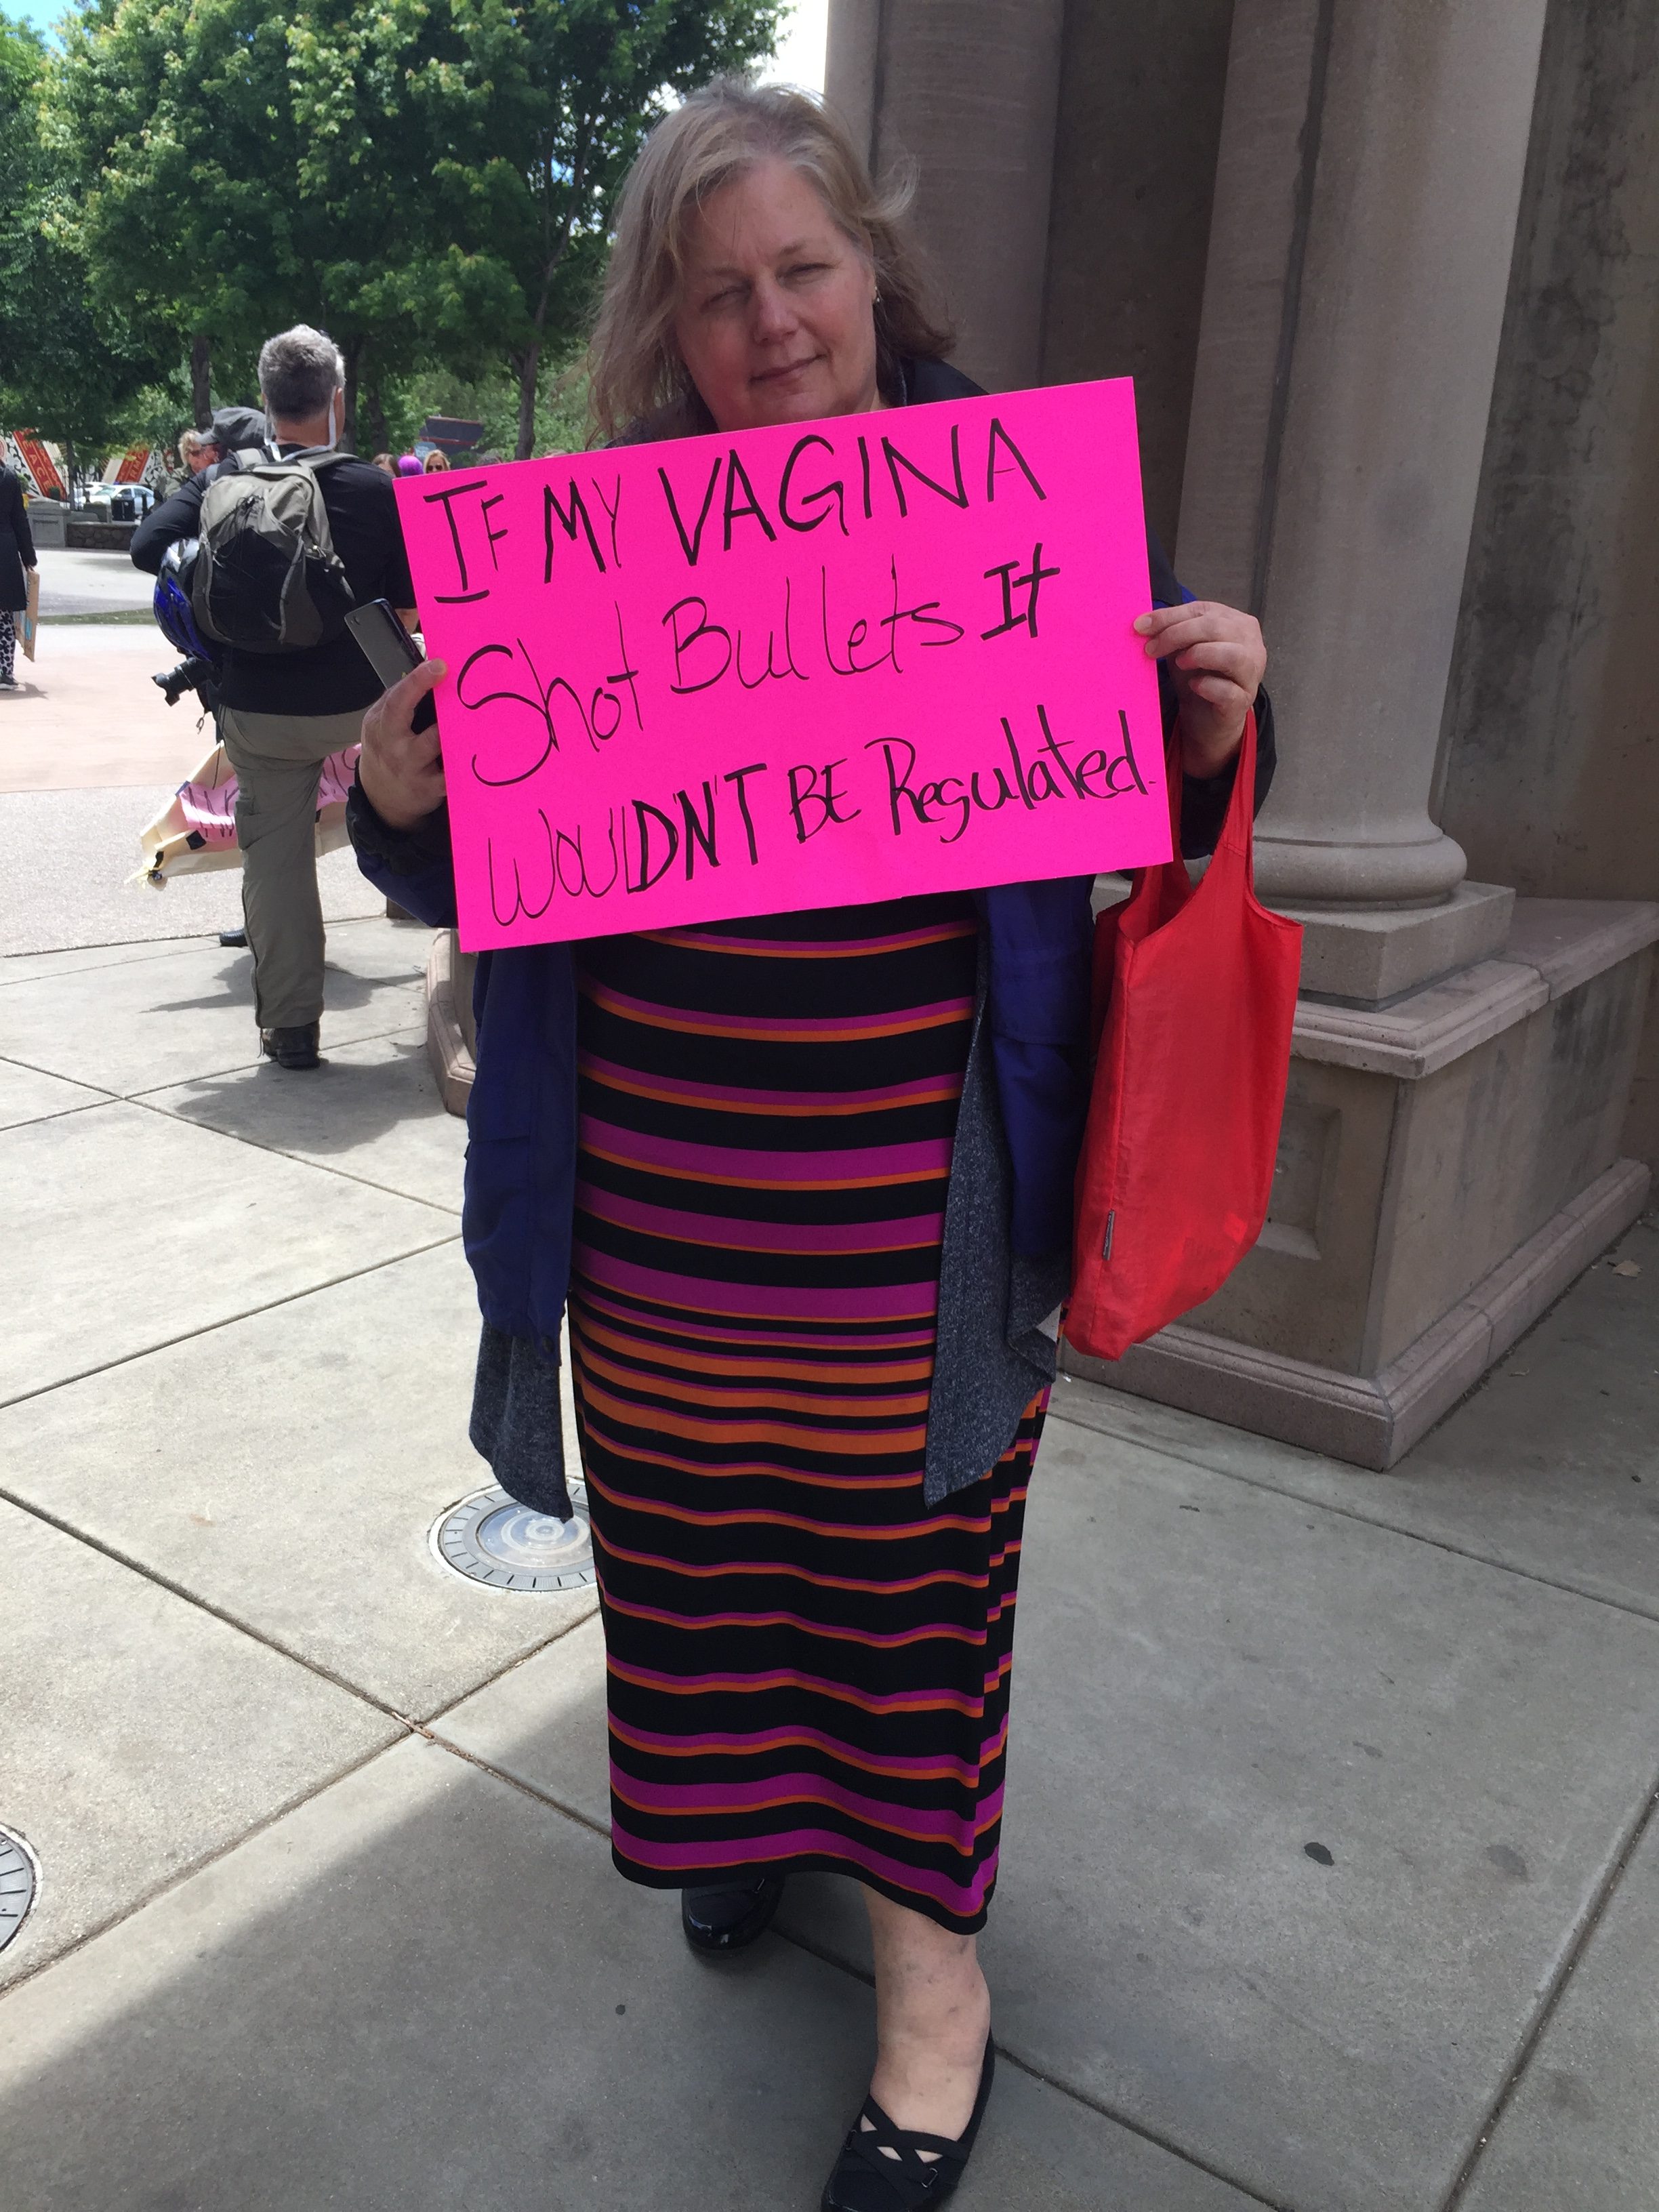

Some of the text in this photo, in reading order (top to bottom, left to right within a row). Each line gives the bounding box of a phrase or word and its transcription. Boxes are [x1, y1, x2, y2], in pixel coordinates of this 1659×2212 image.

[423, 417, 1047, 605] IF MY VAGINA
[457, 542, 1061, 787] Shot Bullets It
[787, 758, 862, 844] BE
